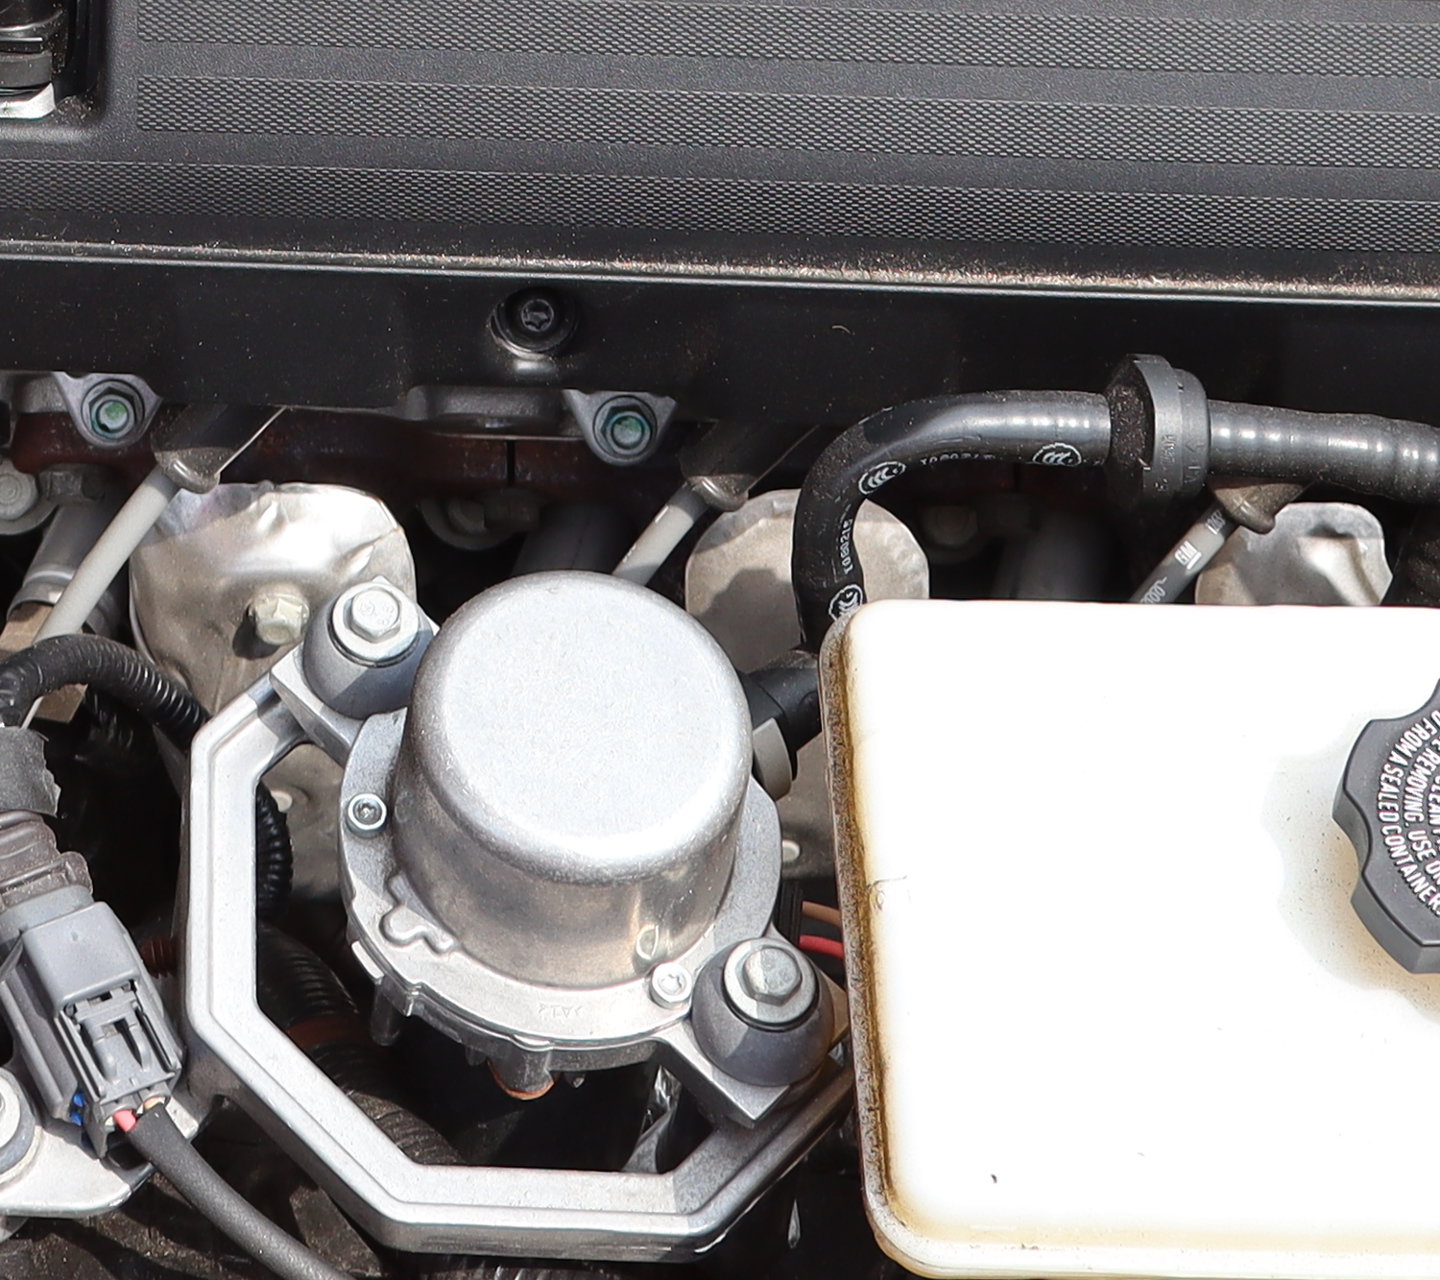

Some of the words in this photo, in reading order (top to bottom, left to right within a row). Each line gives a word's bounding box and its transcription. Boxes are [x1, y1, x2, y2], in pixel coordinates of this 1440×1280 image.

[1174, 540, 1201, 569] GM
[1395, 717, 1438, 759] FROM
[1389, 750, 1409, 767] A
[1377, 763, 1405, 823] SEALED
[1407, 830, 1437, 861] USE
